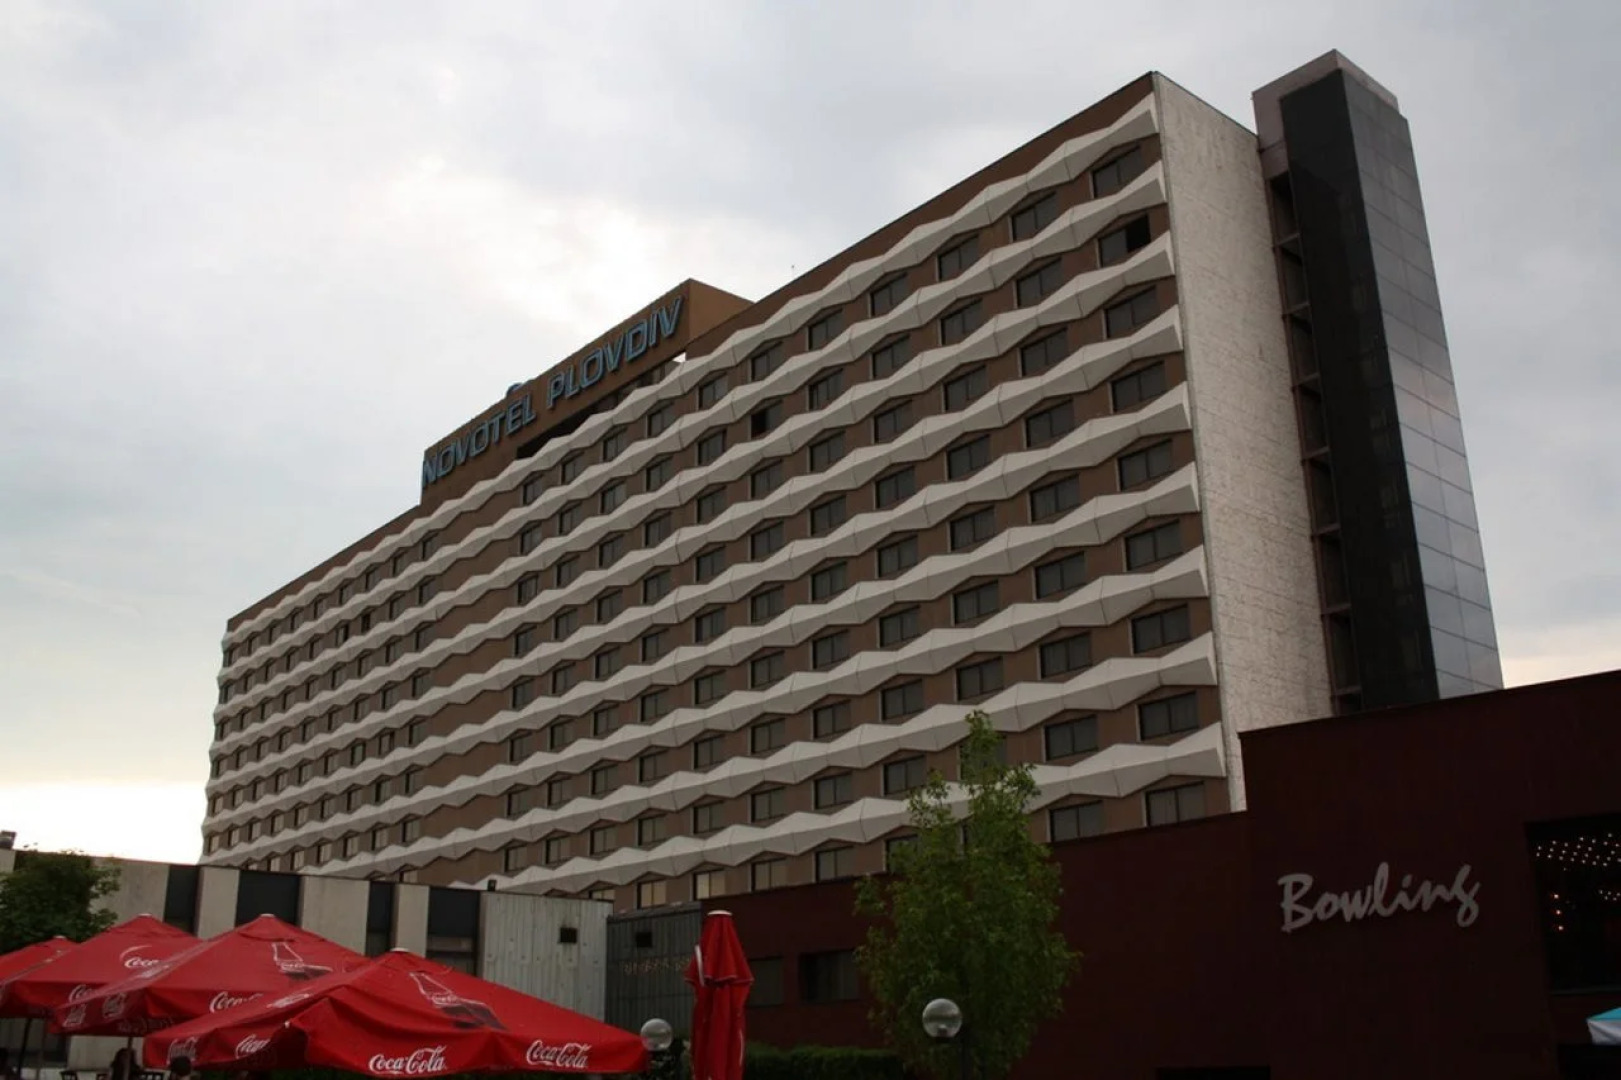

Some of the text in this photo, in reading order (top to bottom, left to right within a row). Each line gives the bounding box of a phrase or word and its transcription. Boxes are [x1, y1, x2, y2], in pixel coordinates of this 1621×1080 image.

[422, 296, 683, 487] NOVOTEL PLOVDIV
[1277, 861, 1481, 933] Bowling
[368, 1044, 447, 1075] Coca-Cola
